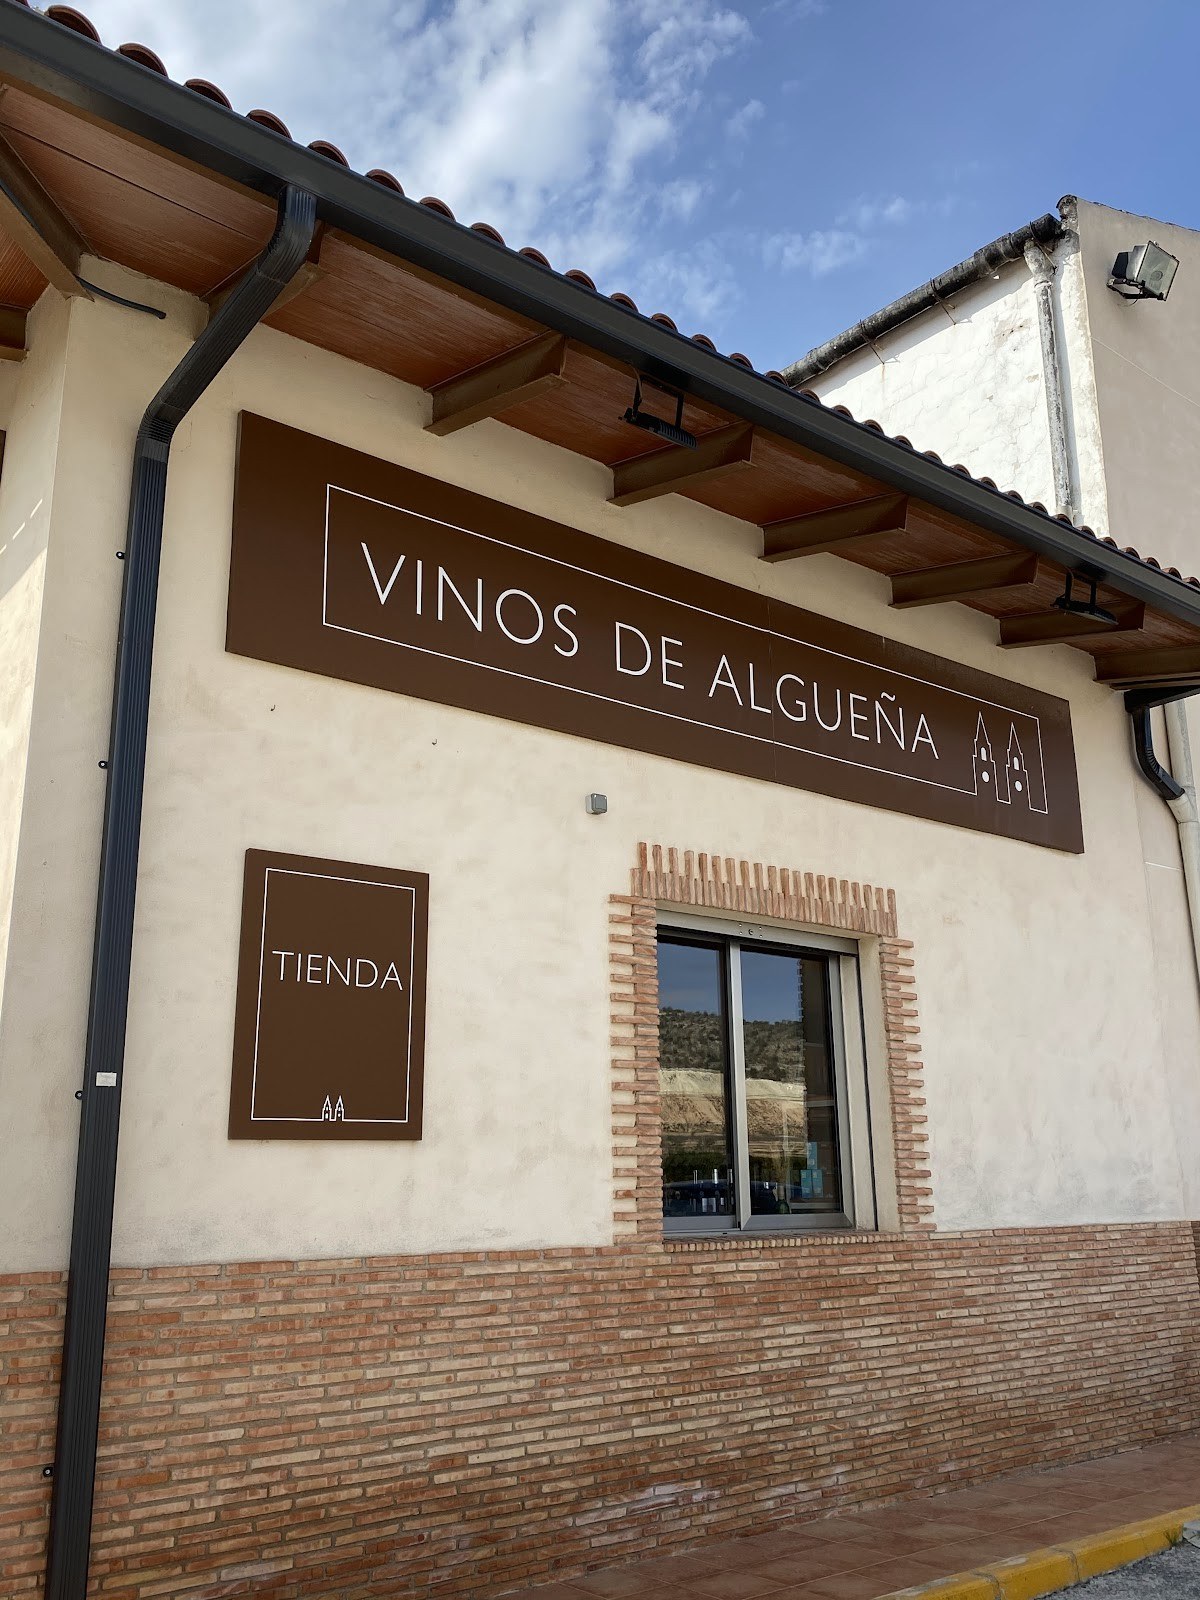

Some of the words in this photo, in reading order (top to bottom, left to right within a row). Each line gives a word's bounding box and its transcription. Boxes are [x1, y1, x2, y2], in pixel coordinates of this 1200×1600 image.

[360, 541, 579, 657] VINOS
[615, 621, 685, 690] DE
[708, 654, 940, 760] ALGUEÑA
[271, 950, 403, 991] TIENDA
